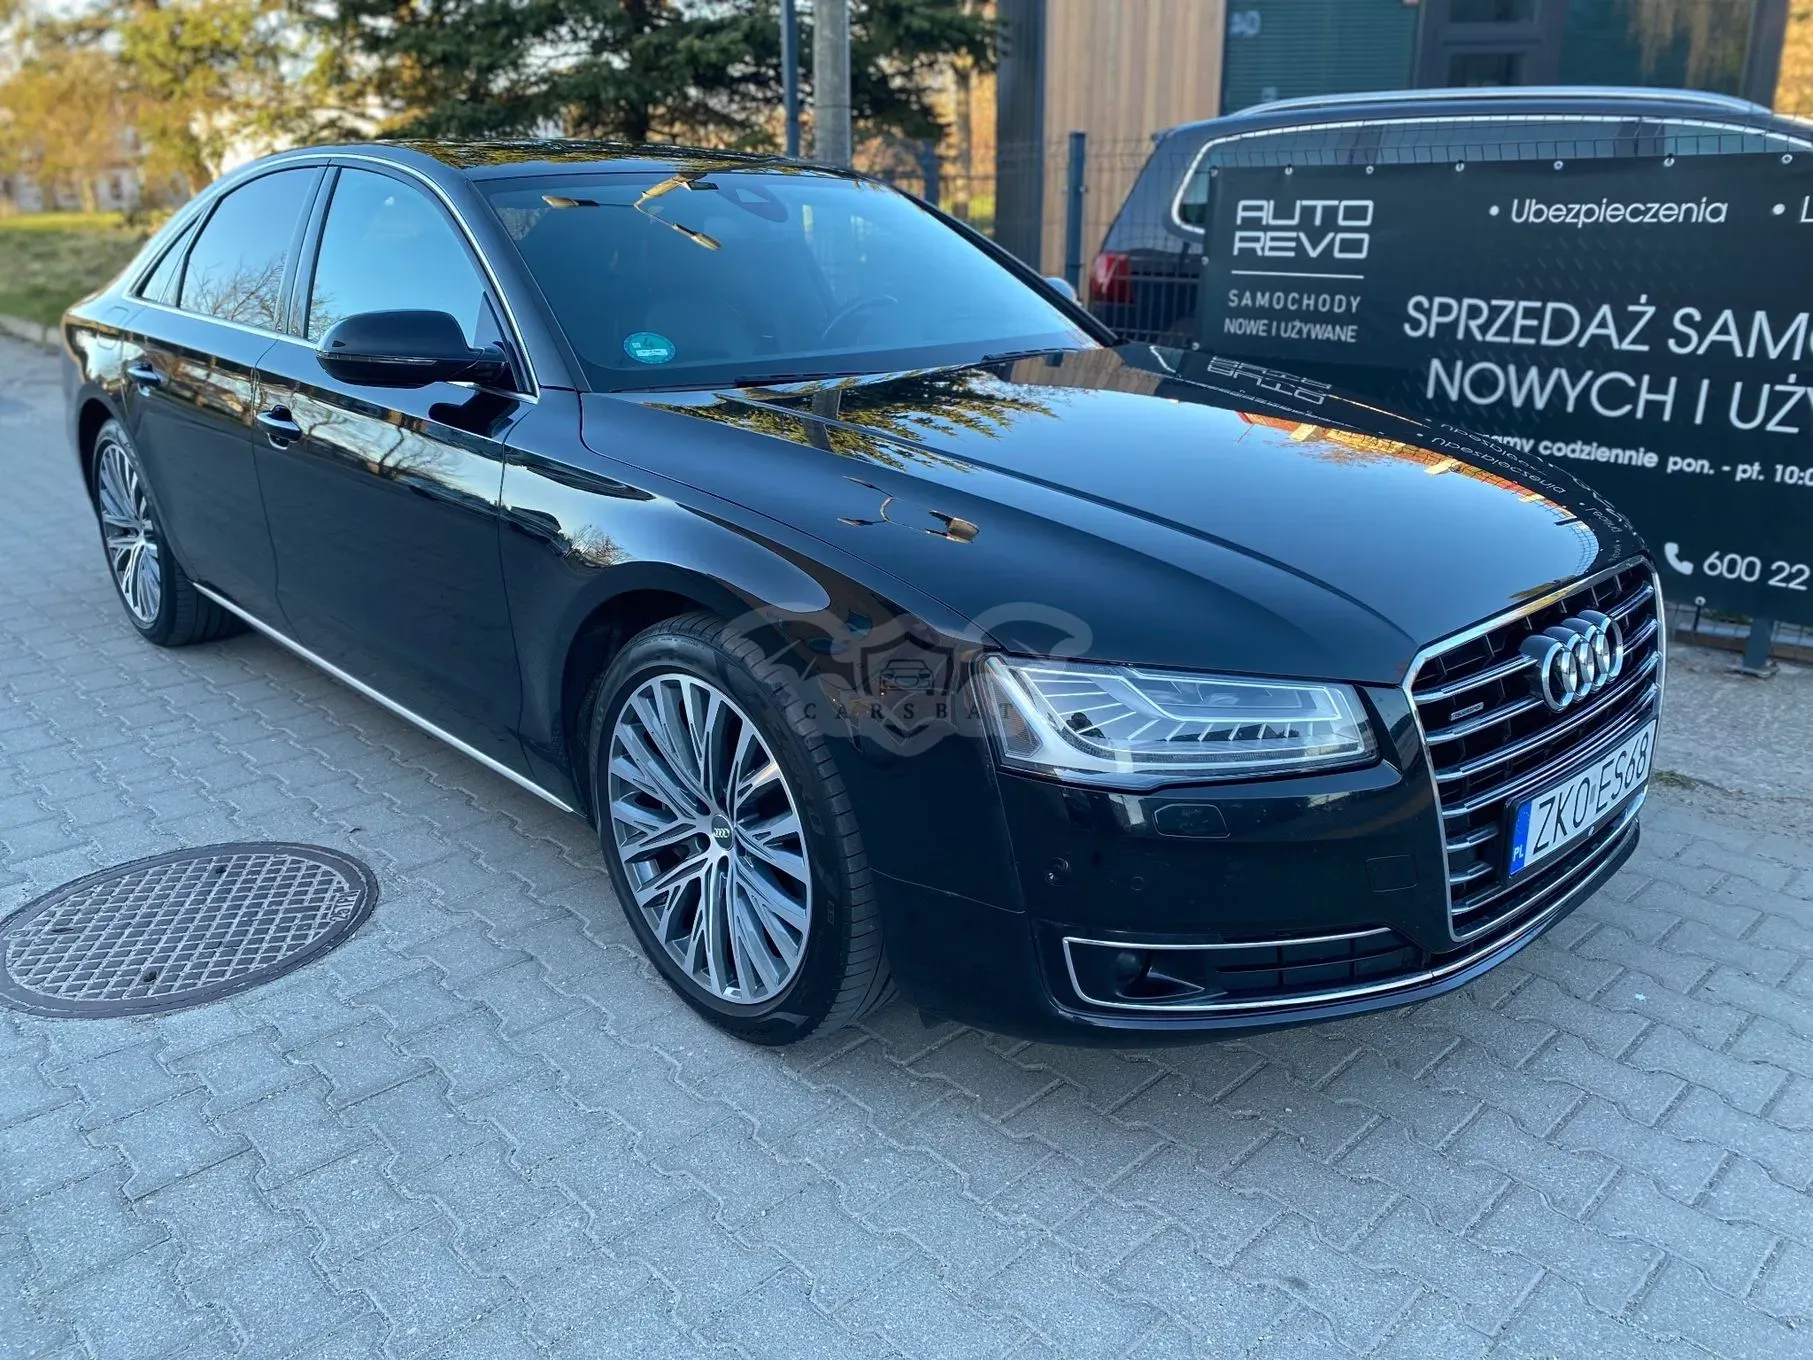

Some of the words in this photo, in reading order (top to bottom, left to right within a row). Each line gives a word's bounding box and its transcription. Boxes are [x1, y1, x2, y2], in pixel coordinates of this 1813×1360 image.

[1236, 199, 1374, 227] AUTO
[1511, 196, 1728, 229] Ubezpieczenia
[1232, 230, 1370, 259] REVO
[1228, 289, 1361, 313] SAMOCHODY
[1223, 317, 1269, 337] NOWE
[1271, 320, 1278, 337] I
[1280, 318, 1358, 343] UŻYWANE
[1403, 294, 1655, 352] SPRZEDAŻ
[1667, 306, 1813, 361] SAM
[1426, 358, 1678, 422] NOWYCH
[1694, 379, 1710, 425] I
[1729, 373, 1813, 434] UŻ
[1538, 439, 1659, 468] codziennie
[1666, 455, 1715, 475] pon.
[1735, 461, 1765, 482] pt.
[1703, 551, 1762, 582] 600
[1767, 561, 1811, 591] 22
[1533, 777, 1590, 855] ZKO
[1596, 731, 1649, 814] ES68
[1512, 845, 1525, 862] PL
